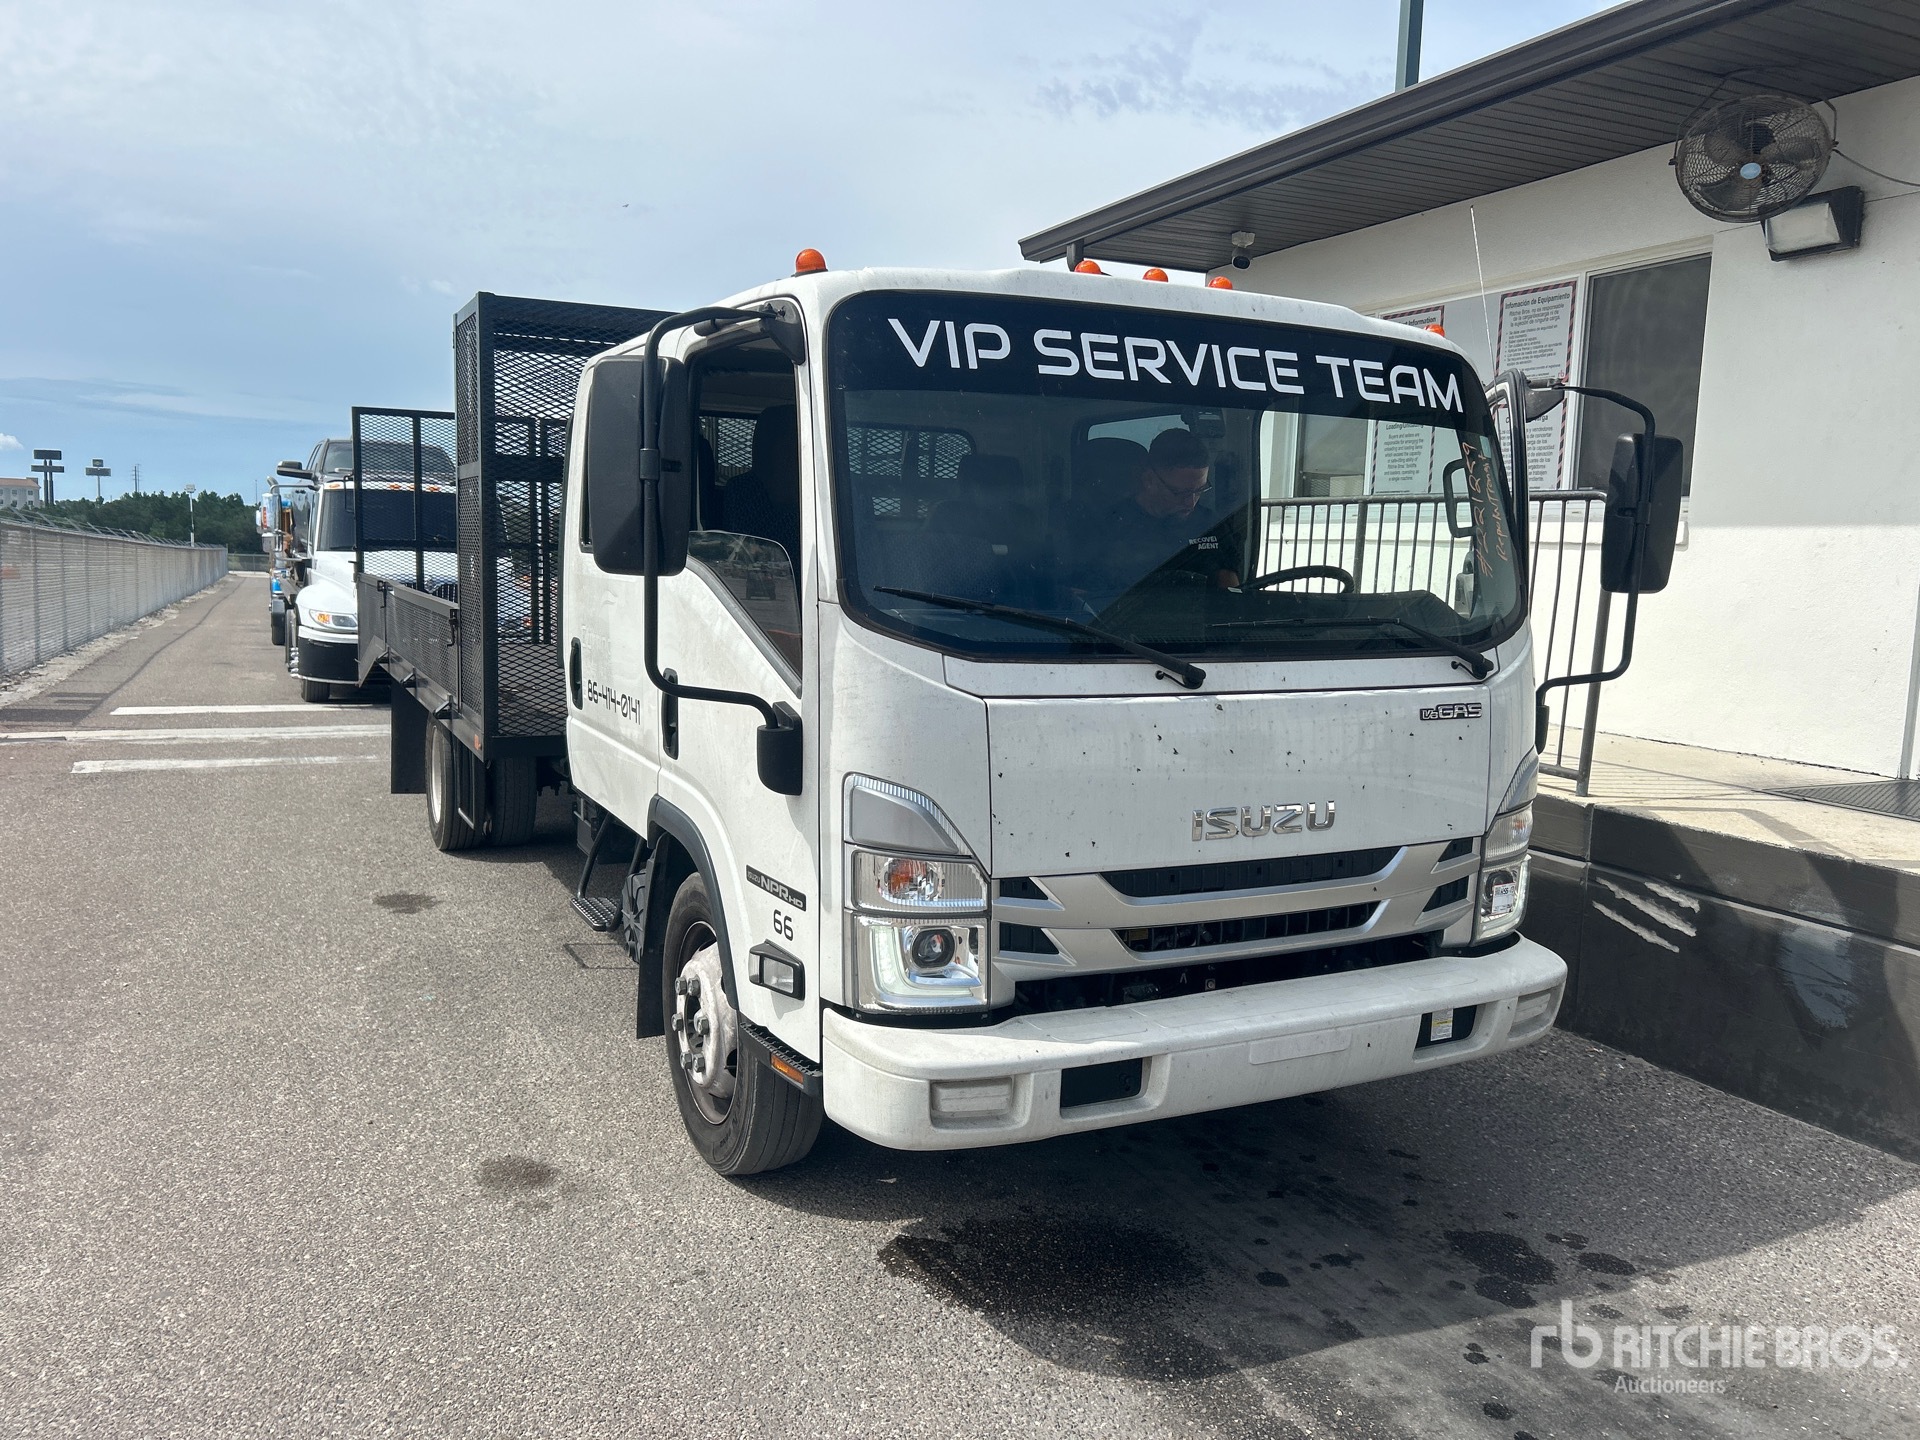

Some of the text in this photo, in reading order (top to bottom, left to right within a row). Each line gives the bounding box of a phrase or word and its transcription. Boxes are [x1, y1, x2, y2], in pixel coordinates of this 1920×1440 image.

[1538, 293, 1570, 304] Equipamiento
[888, 318, 1463, 413] VIP SERVICE TEAM
[1198, 542, 1219, 550] AGENT
[588, 679, 641, 725] 86-414-0141
[1438, 704, 1482, 719] GAS
[1192, 800, 1335, 842] ISUZU
[761, 875, 789, 901] NPR
[789, 895, 804, 908] HD
[774, 909, 794, 941] 66
